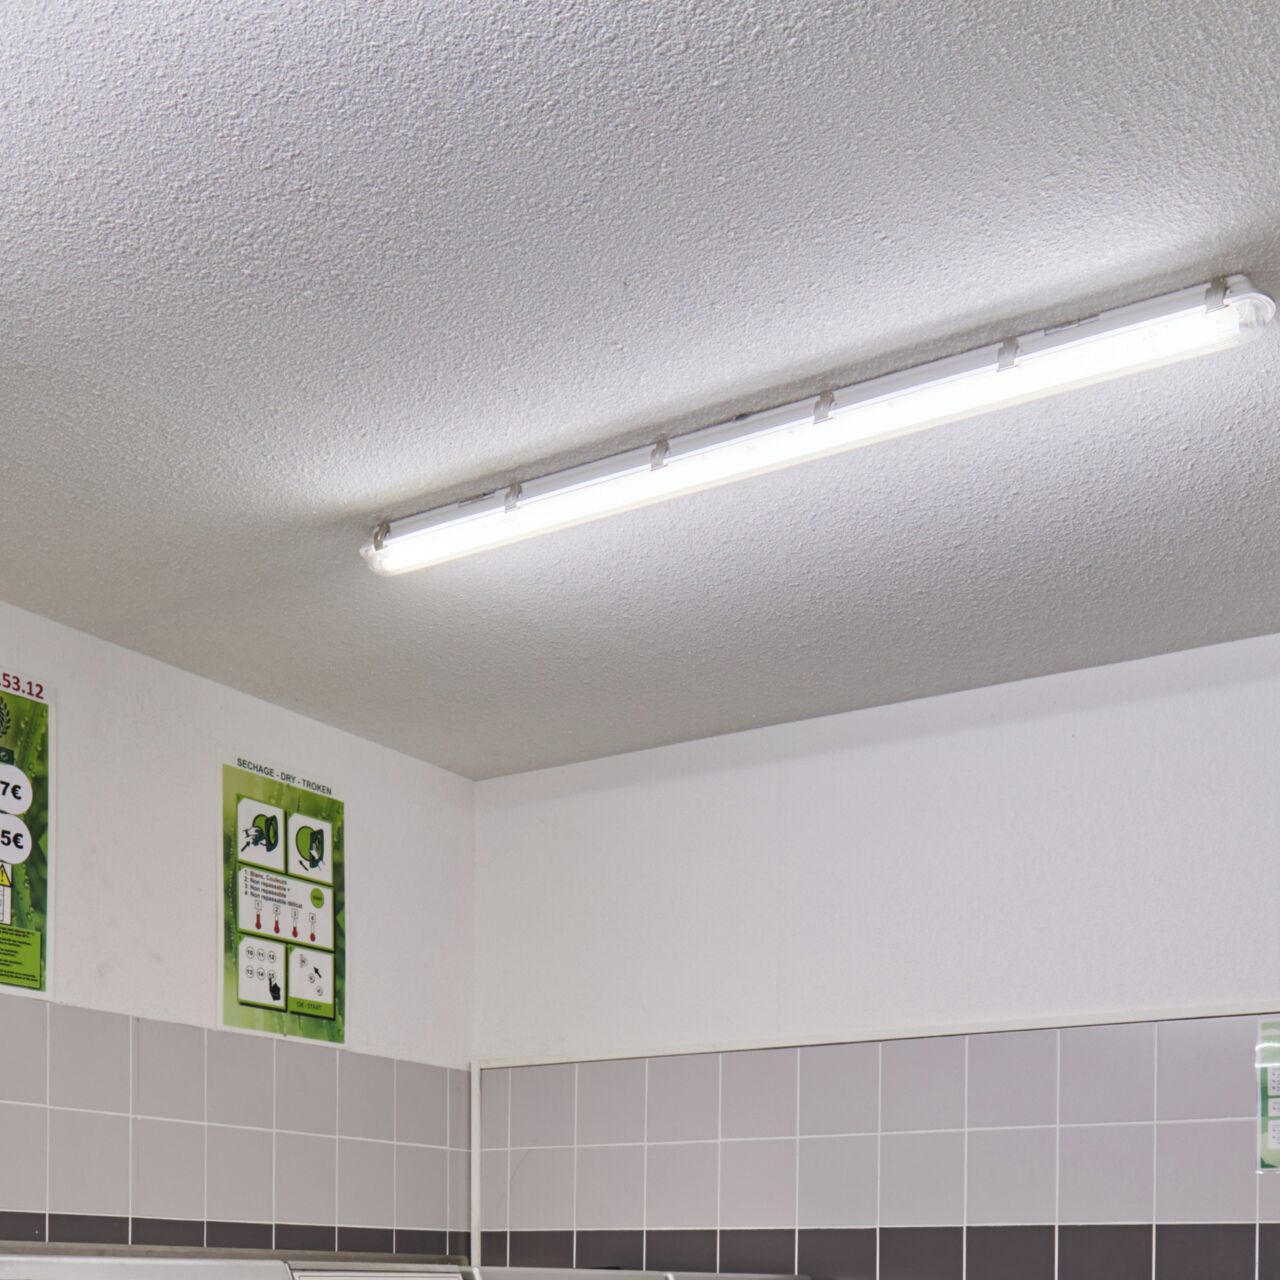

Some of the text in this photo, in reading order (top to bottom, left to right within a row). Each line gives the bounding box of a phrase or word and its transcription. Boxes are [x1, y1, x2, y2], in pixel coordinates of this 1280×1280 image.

[237, 758, 332, 796] SECHAGE DRY TROKEN
[0, 780, 22, 800] 7€
[1, 829, 24, 849] 5€
